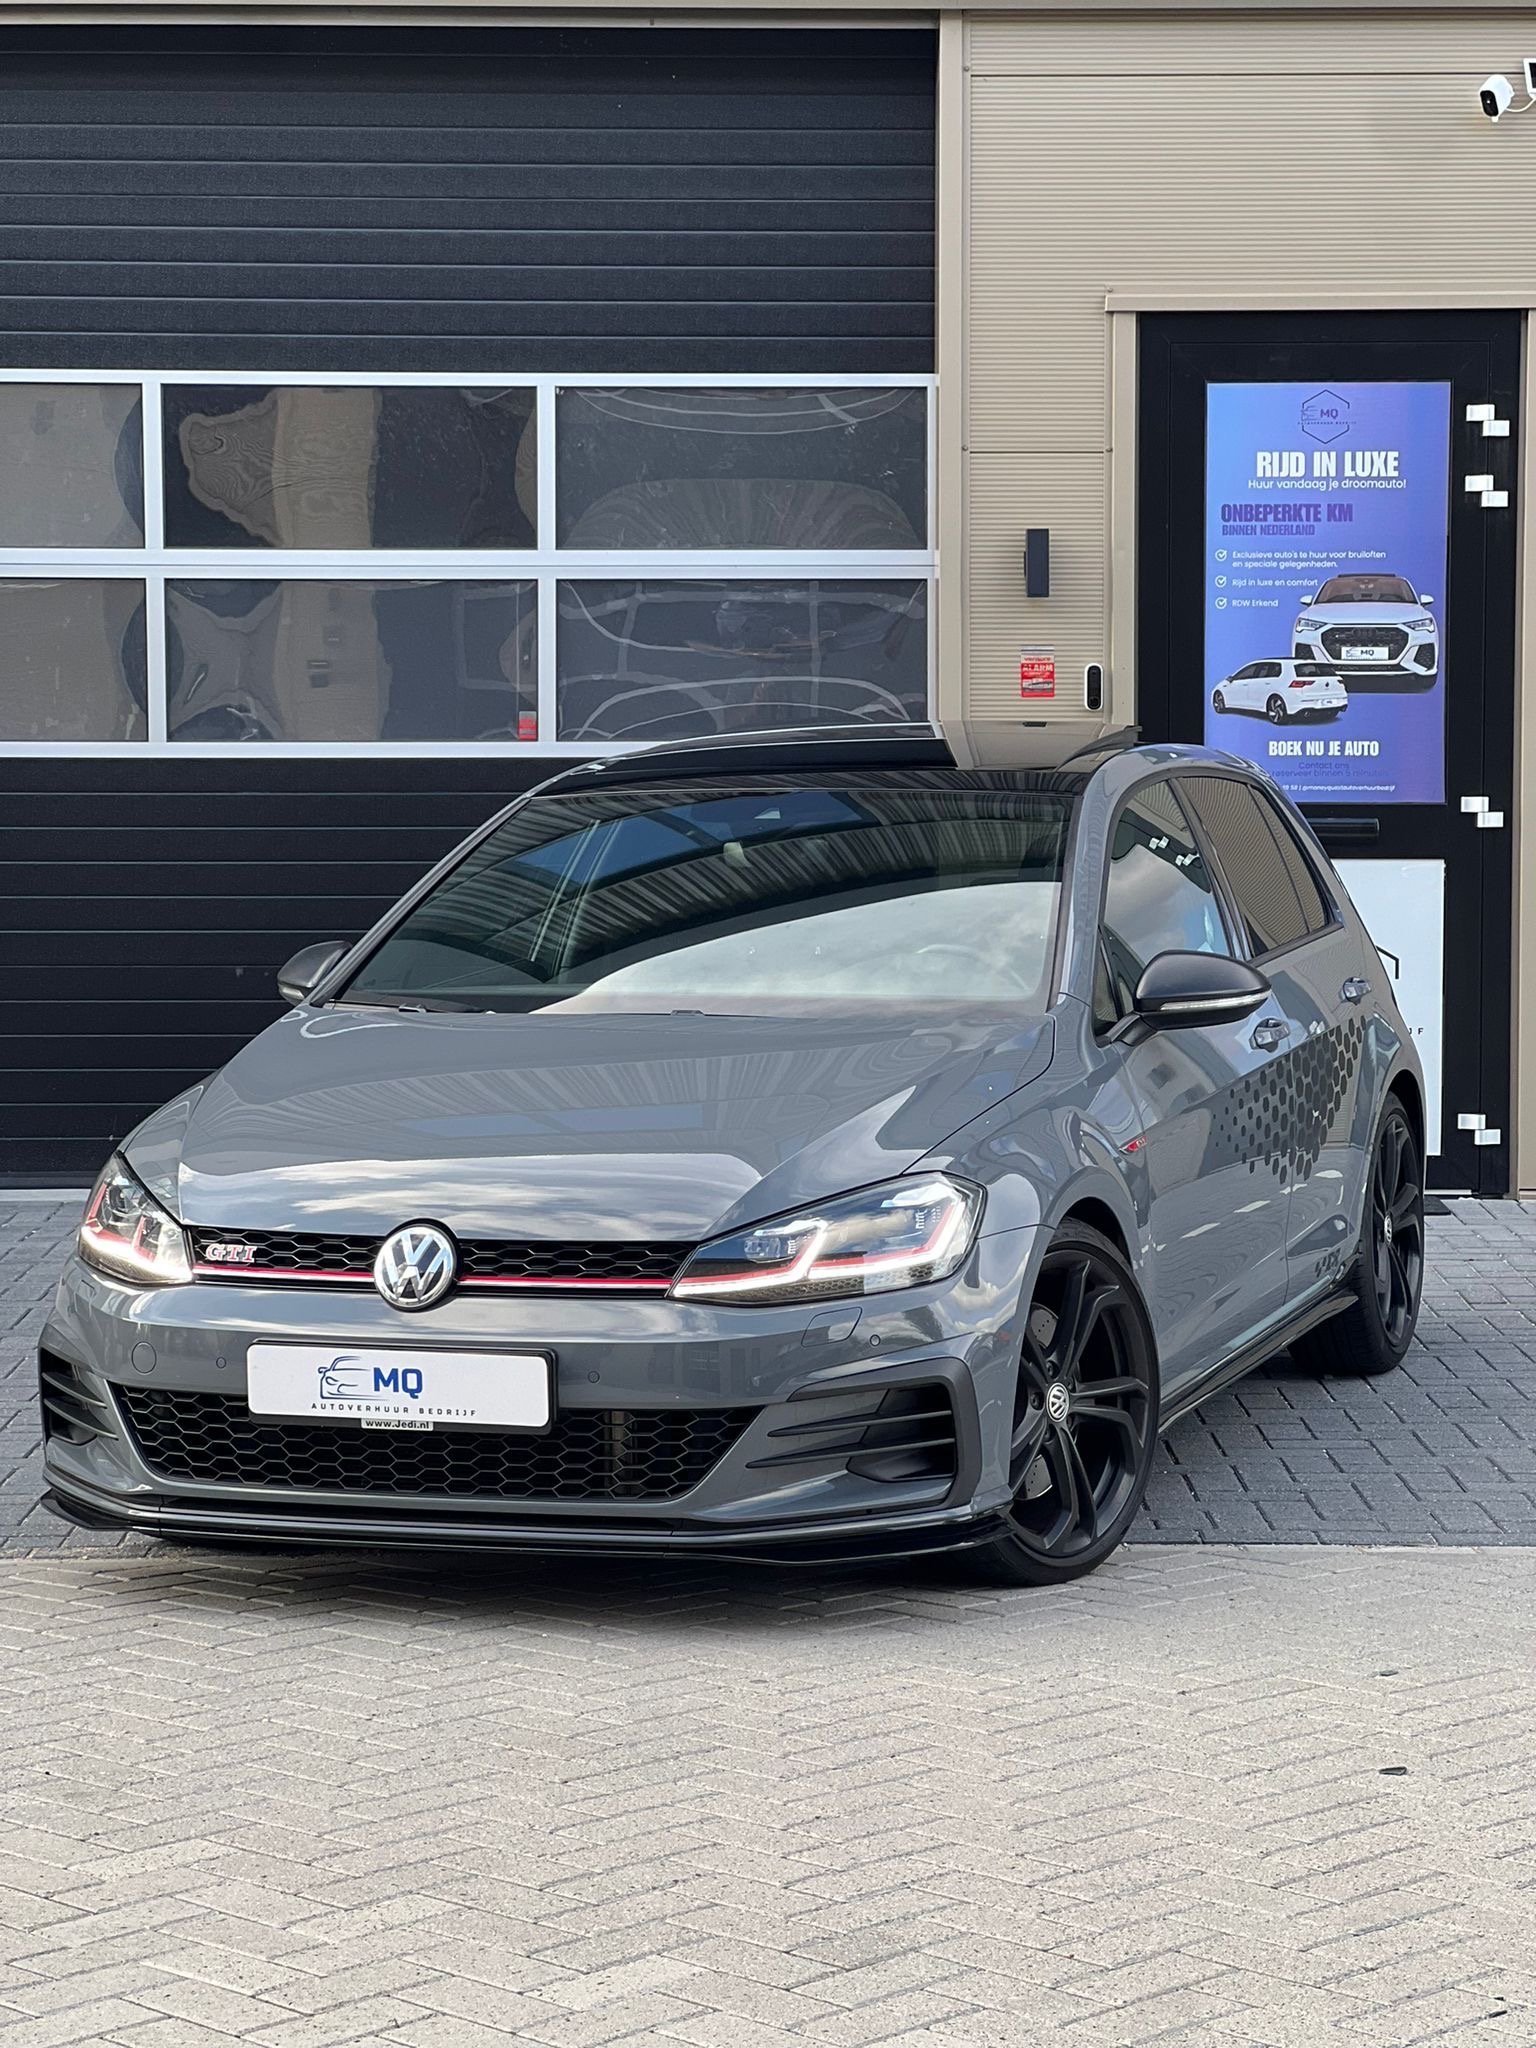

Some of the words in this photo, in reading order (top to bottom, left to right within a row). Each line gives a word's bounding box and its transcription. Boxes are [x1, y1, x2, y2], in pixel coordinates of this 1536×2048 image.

[1320, 408, 1338, 419] MQ
[1256, 451, 1306, 478] RIJD
[1312, 451, 1337, 478] IN
[1344, 451, 1399, 477] LUXE
[1248, 479, 1274, 489] Huur
[1276, 479, 1327, 491] vandaag
[1328, 479, 1339, 491] je
[1341, 479, 1407, 489] droomauto!
[1221, 503, 1322, 522] ONBEPERKTE
[1326, 503, 1353, 522] KM
[1222, 524, 1257, 536] BINNEN
[1260, 524, 1315, 536] NEDERLAND
[1232, 550, 1273, 559] Exclusieve
[1274, 550, 1298, 559] auto's
[1309, 550, 1328, 558] huur
[1348, 550, 1387, 558] bruiloften
[1244, 560, 1278, 569] speciale
[1279, 560, 1338, 570] gelegenheden.
[1232, 578, 1247, 588] Rijd
[1247, 578, 1256, 586] in
[1257, 578, 1273, 586] luxe
[1286, 578, 1318, 586] comfort
[1232, 599, 1250, 607] RDW
[1251, 599, 1279, 607] Erkend
[1269, 741, 1303, 756] BOEK
[1306, 741, 1324, 756] NU
[1328, 741, 1341, 756] JE
[1344, 741, 1380, 756] AUTO
[1298, 761, 1332, 770] Contact
[205, 1243, 257, 1262] GTI
[373, 1367, 423, 1399] MQ
[311, 1403, 409, 1414] AUTOVERHUUR
[419, 1407, 477, 1417] BEDRIJF
[365, 1419, 430, 1429] www.Jedi.nl
